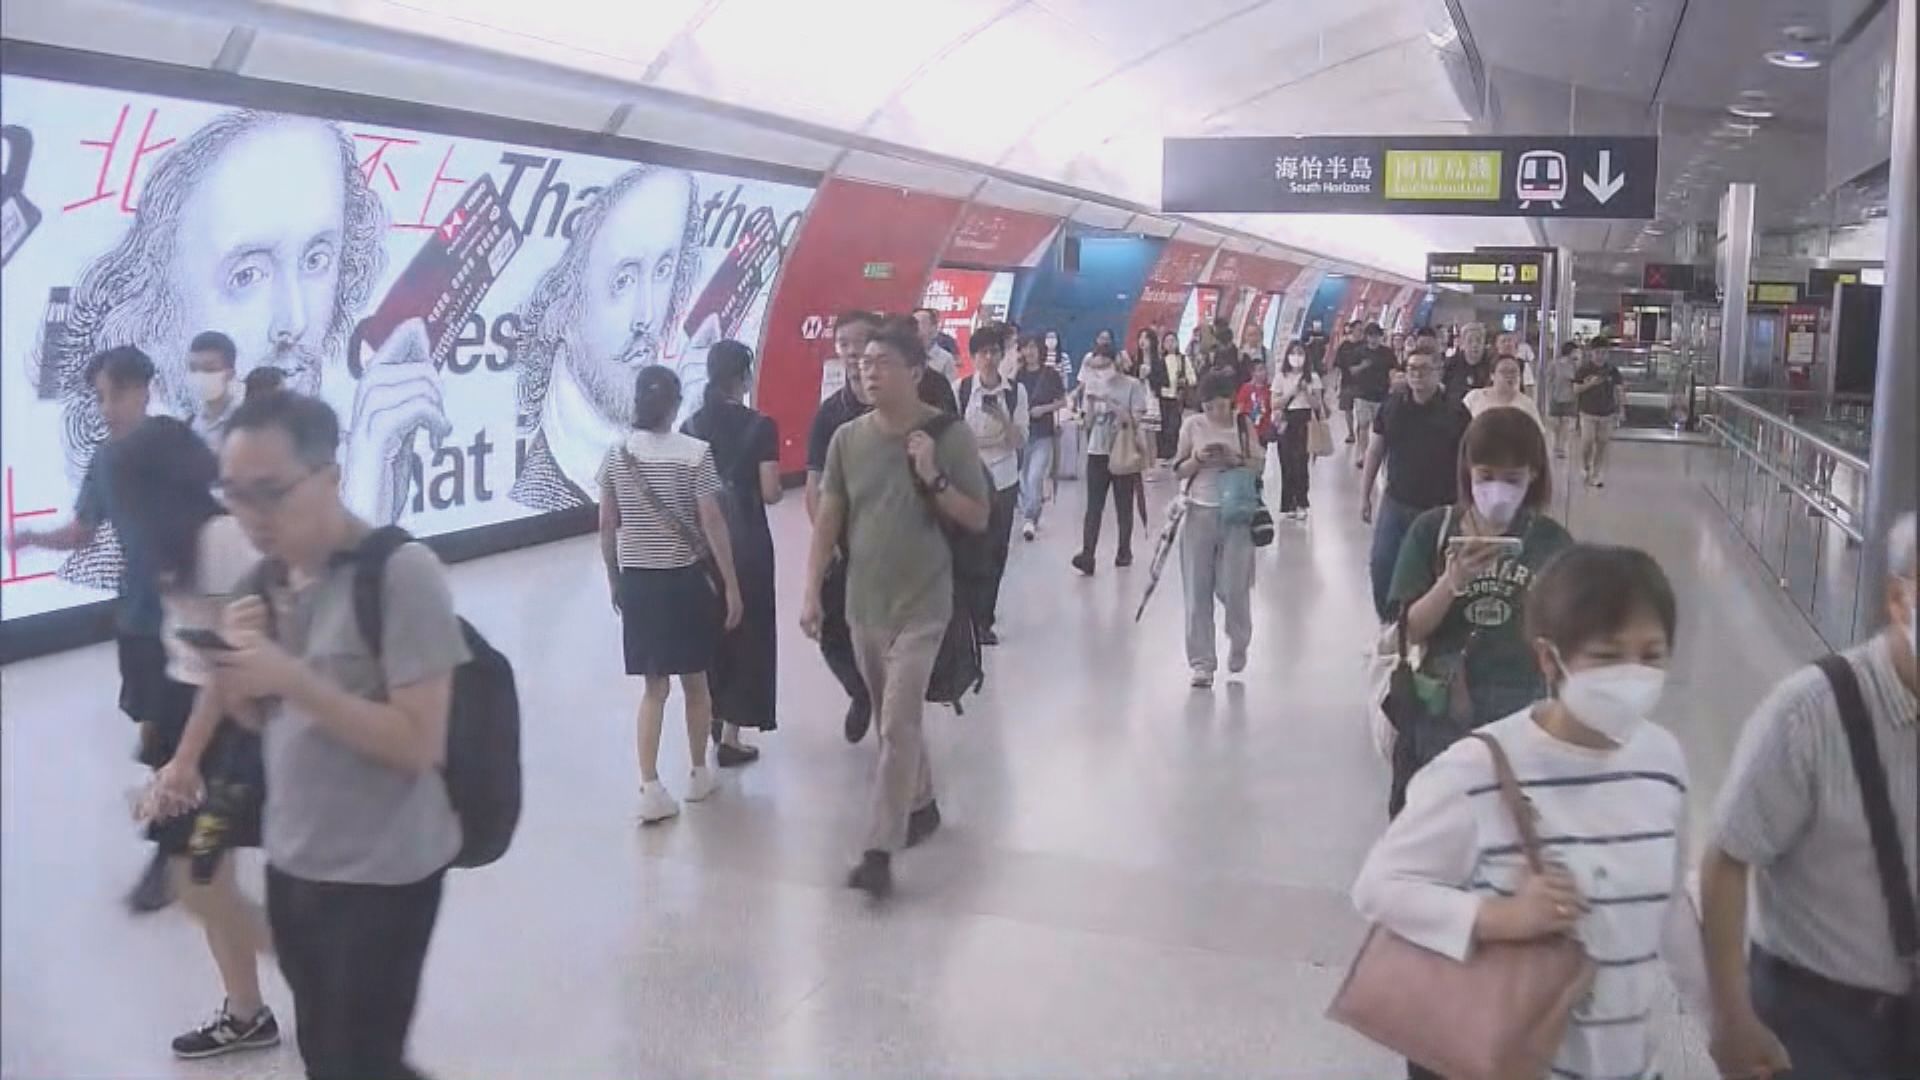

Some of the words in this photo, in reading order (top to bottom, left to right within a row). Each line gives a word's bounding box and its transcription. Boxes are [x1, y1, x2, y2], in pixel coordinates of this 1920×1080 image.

[62, 104, 176, 213] 北
[1275, 156, 1373, 180] 海怡半島
[1289, 182, 1321, 194] South
[1323, 182, 1371, 194] Horizons
